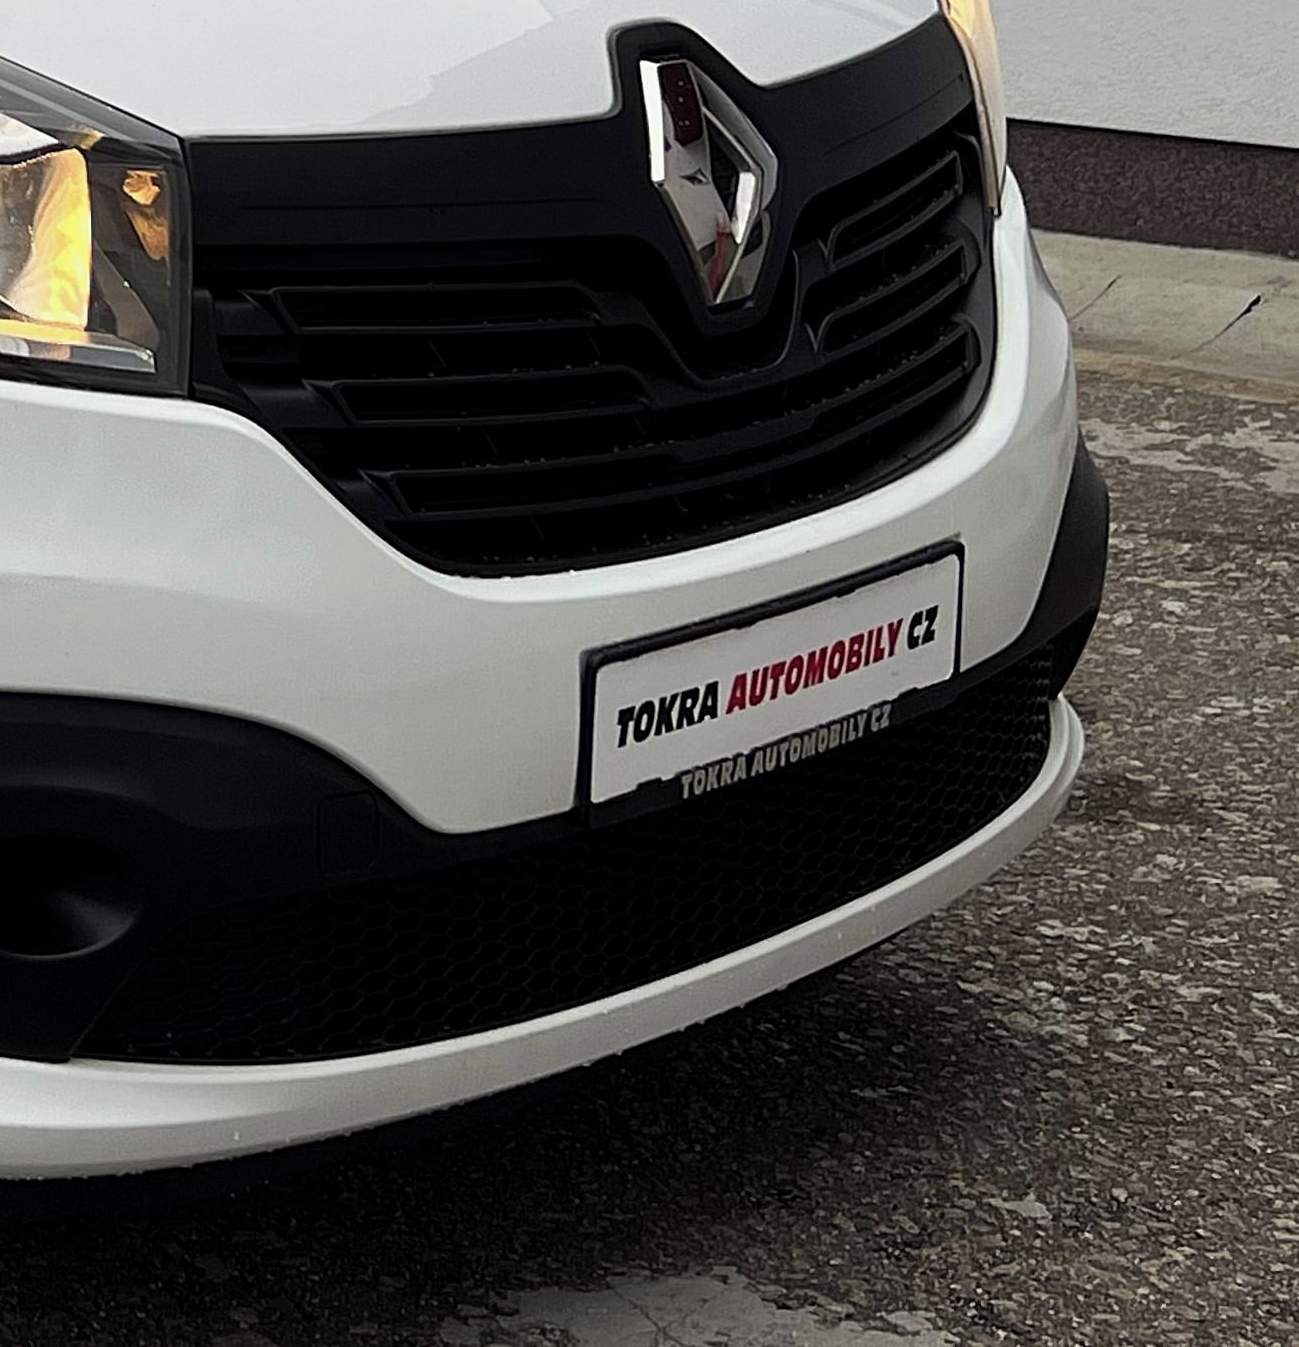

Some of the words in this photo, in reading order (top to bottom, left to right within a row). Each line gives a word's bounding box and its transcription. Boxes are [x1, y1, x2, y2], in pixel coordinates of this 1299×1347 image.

[617, 681, 719, 748] TOKRA
[725, 618, 903, 714] AUTOMOBILY
[906, 605, 939, 650] CZ
[681, 756, 747, 799] TOKRA
[751, 713, 867, 776] AUTOMOBILY
[870, 704, 892, 732] CZ
